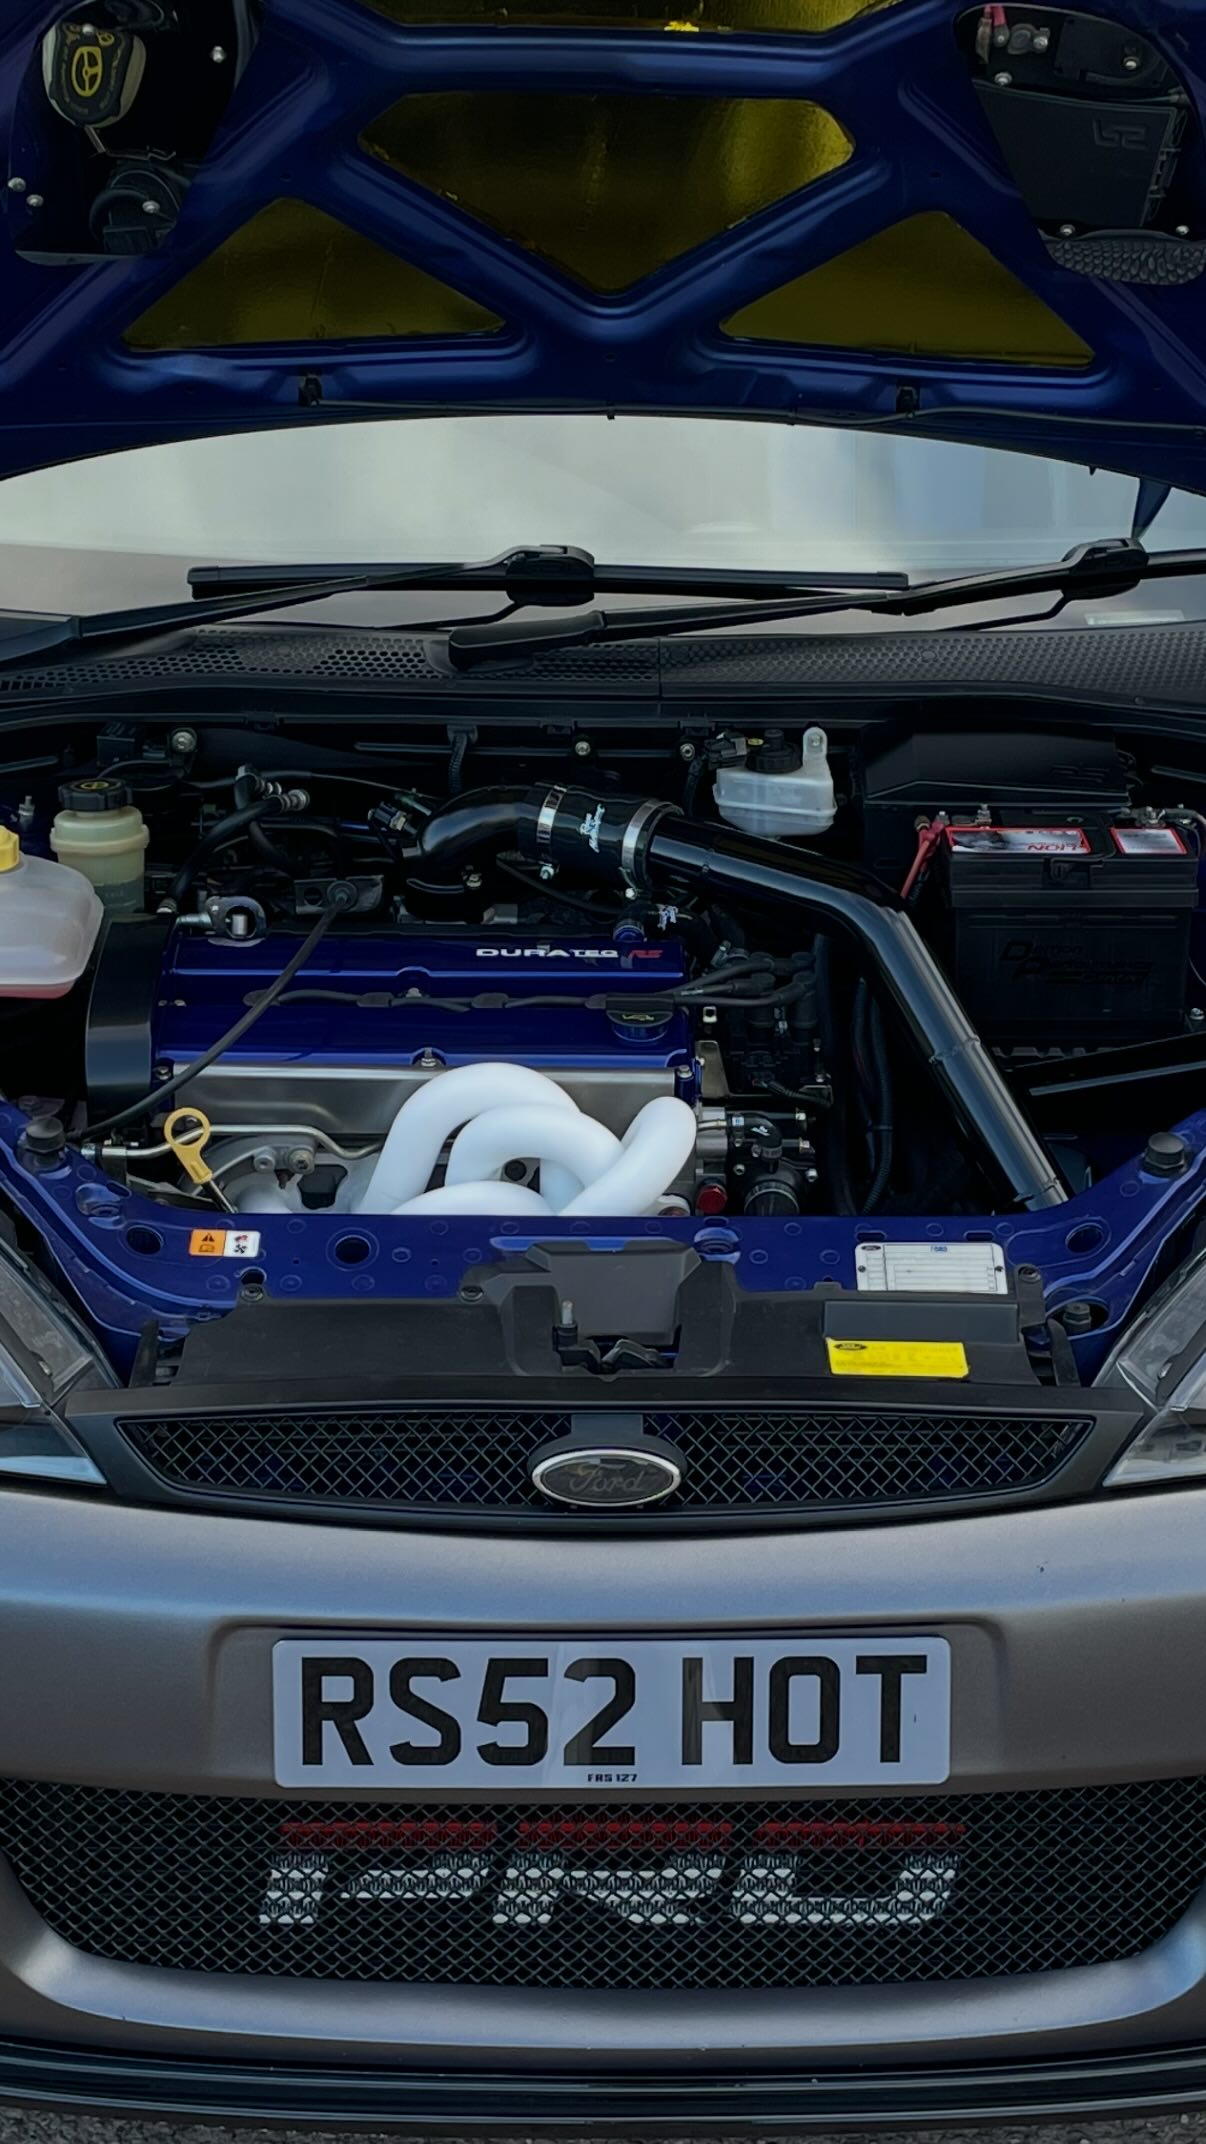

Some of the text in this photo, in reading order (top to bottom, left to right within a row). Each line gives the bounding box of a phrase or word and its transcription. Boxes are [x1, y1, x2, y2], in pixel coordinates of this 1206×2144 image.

[568, 1464, 650, 1494] Ford
[302, 1655, 927, 1766] RS52 HOT
[616, 1773, 638, 1782] 127
